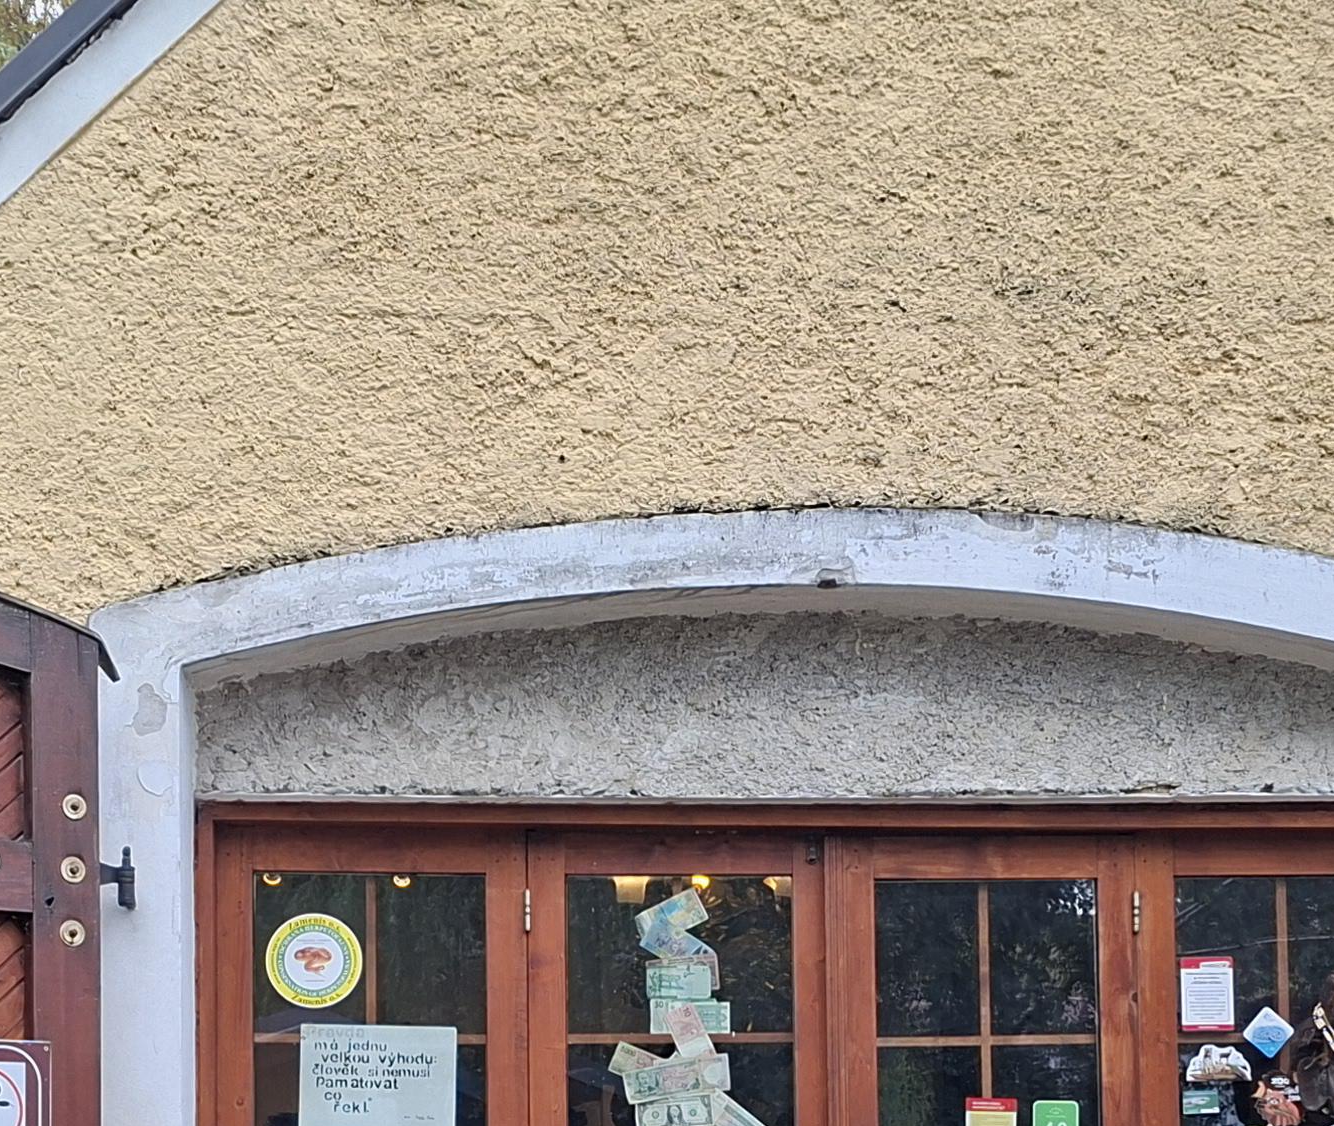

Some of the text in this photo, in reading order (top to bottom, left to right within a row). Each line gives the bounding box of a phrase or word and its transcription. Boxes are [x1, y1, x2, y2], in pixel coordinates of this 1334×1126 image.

[315, 1039, 387, 1053] má jednu
[322, 1052, 370, 1063] velkou
[312, 1063, 358, 1075] člověk
[368, 1066, 378, 1077] si
[324, 1092, 342, 1101] co
